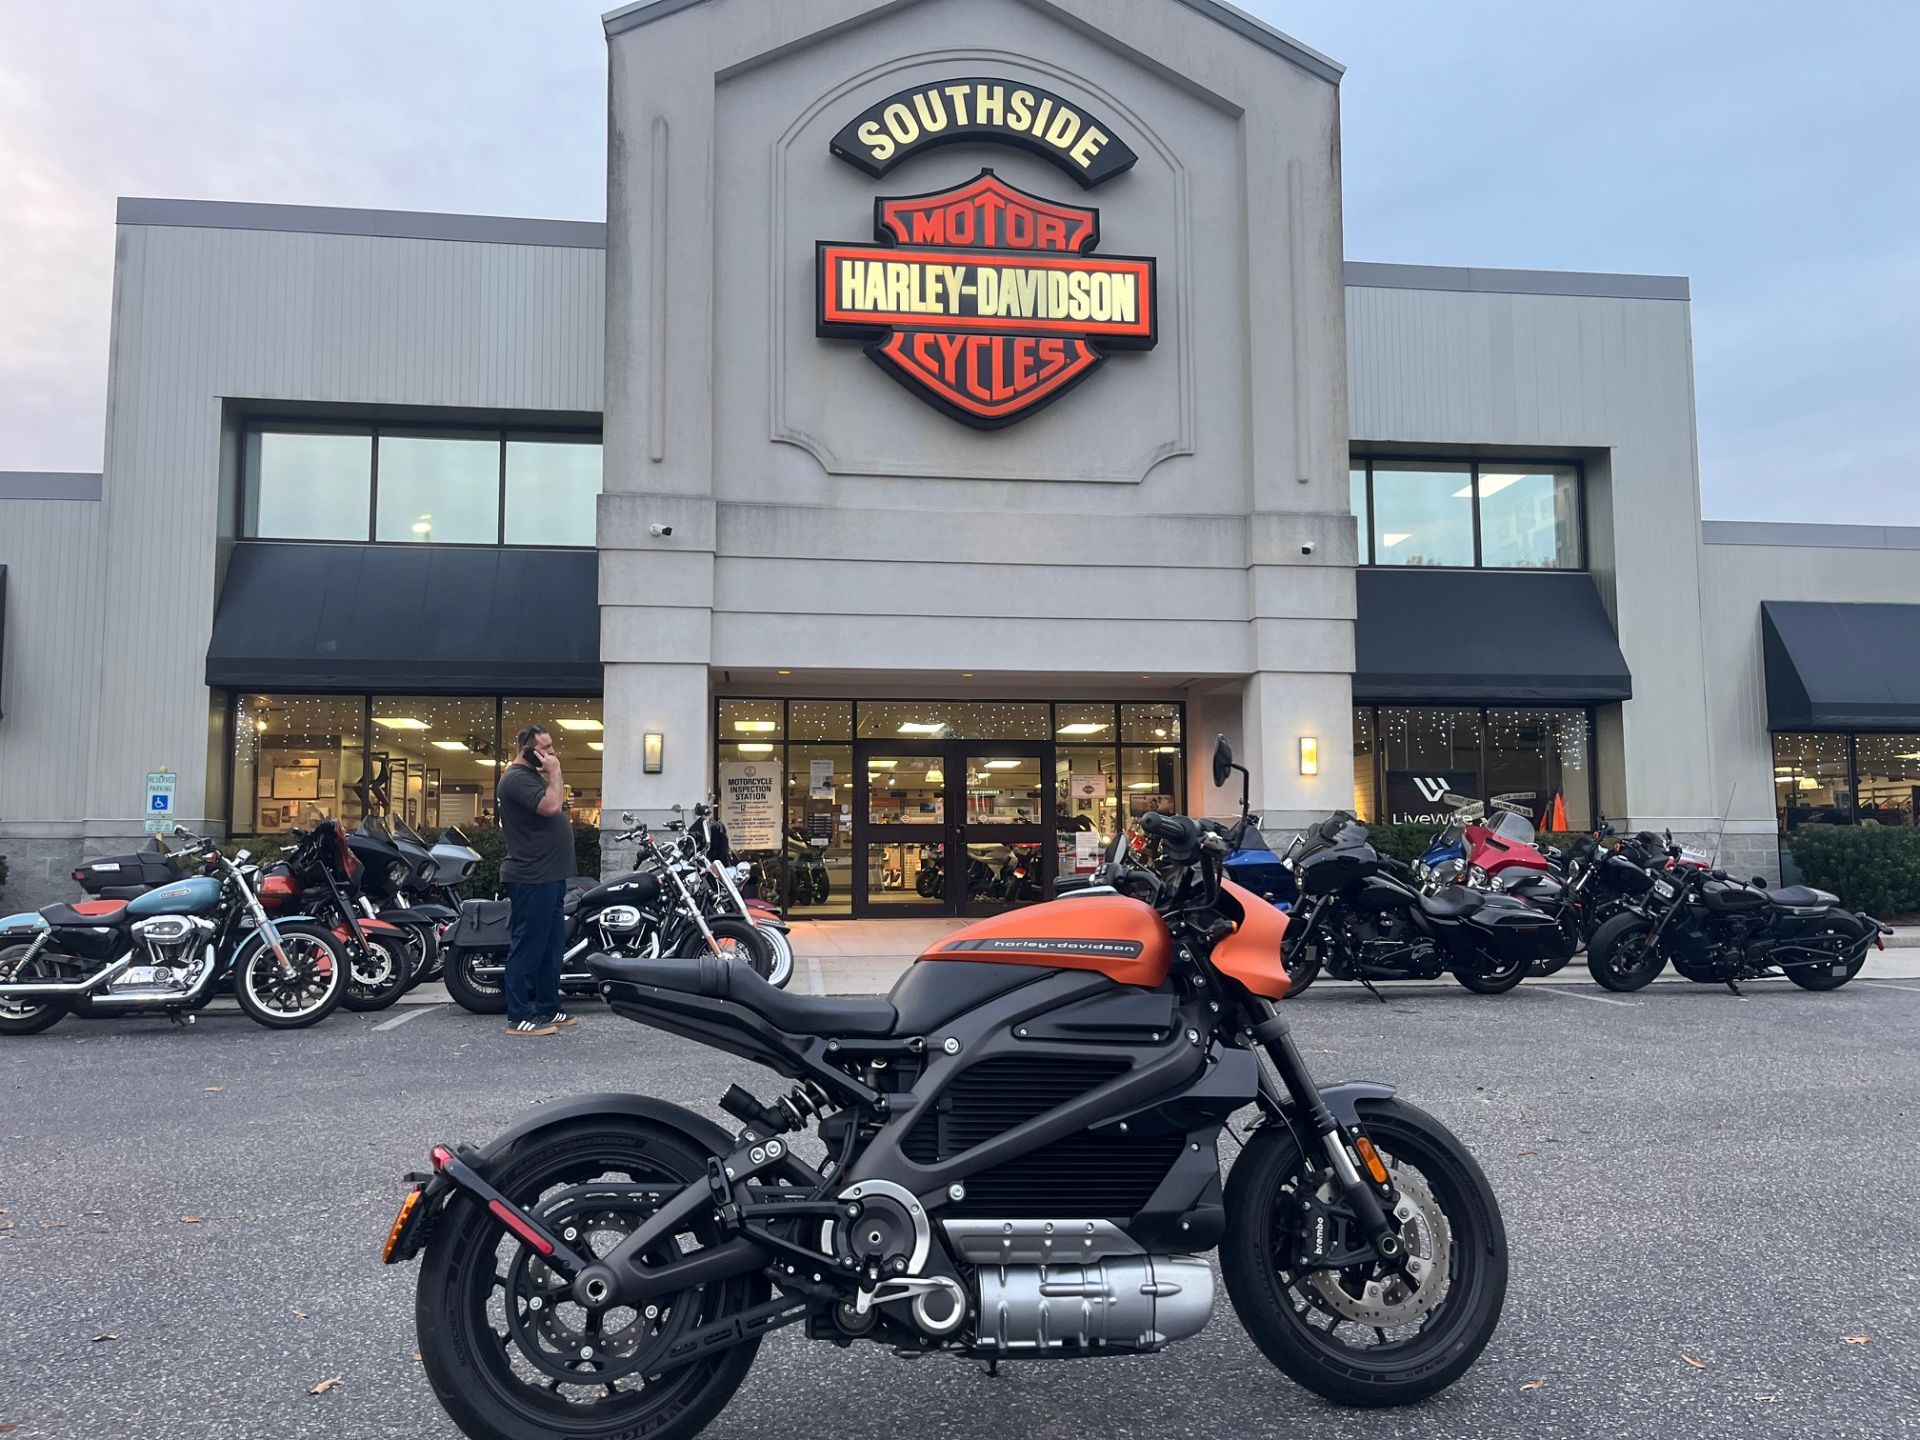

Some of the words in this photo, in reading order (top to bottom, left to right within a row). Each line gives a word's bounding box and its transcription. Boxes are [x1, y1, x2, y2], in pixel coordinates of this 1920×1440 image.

[857, 84, 1109, 169] SOUTHSIDE
[912, 191, 1066, 250] MOTOR
[841, 260, 1136, 323] HARLEY-DAVIDSON
[913, 333, 1068, 401] CYCLES
[728, 778, 773, 786] MOTORCYCLE
[730, 785, 771, 793] INSPECTION
[735, 793, 767, 801] STATION
[994, 940, 1135, 952] harley-davidson
[1314, 1217, 1324, 1255] brembo
